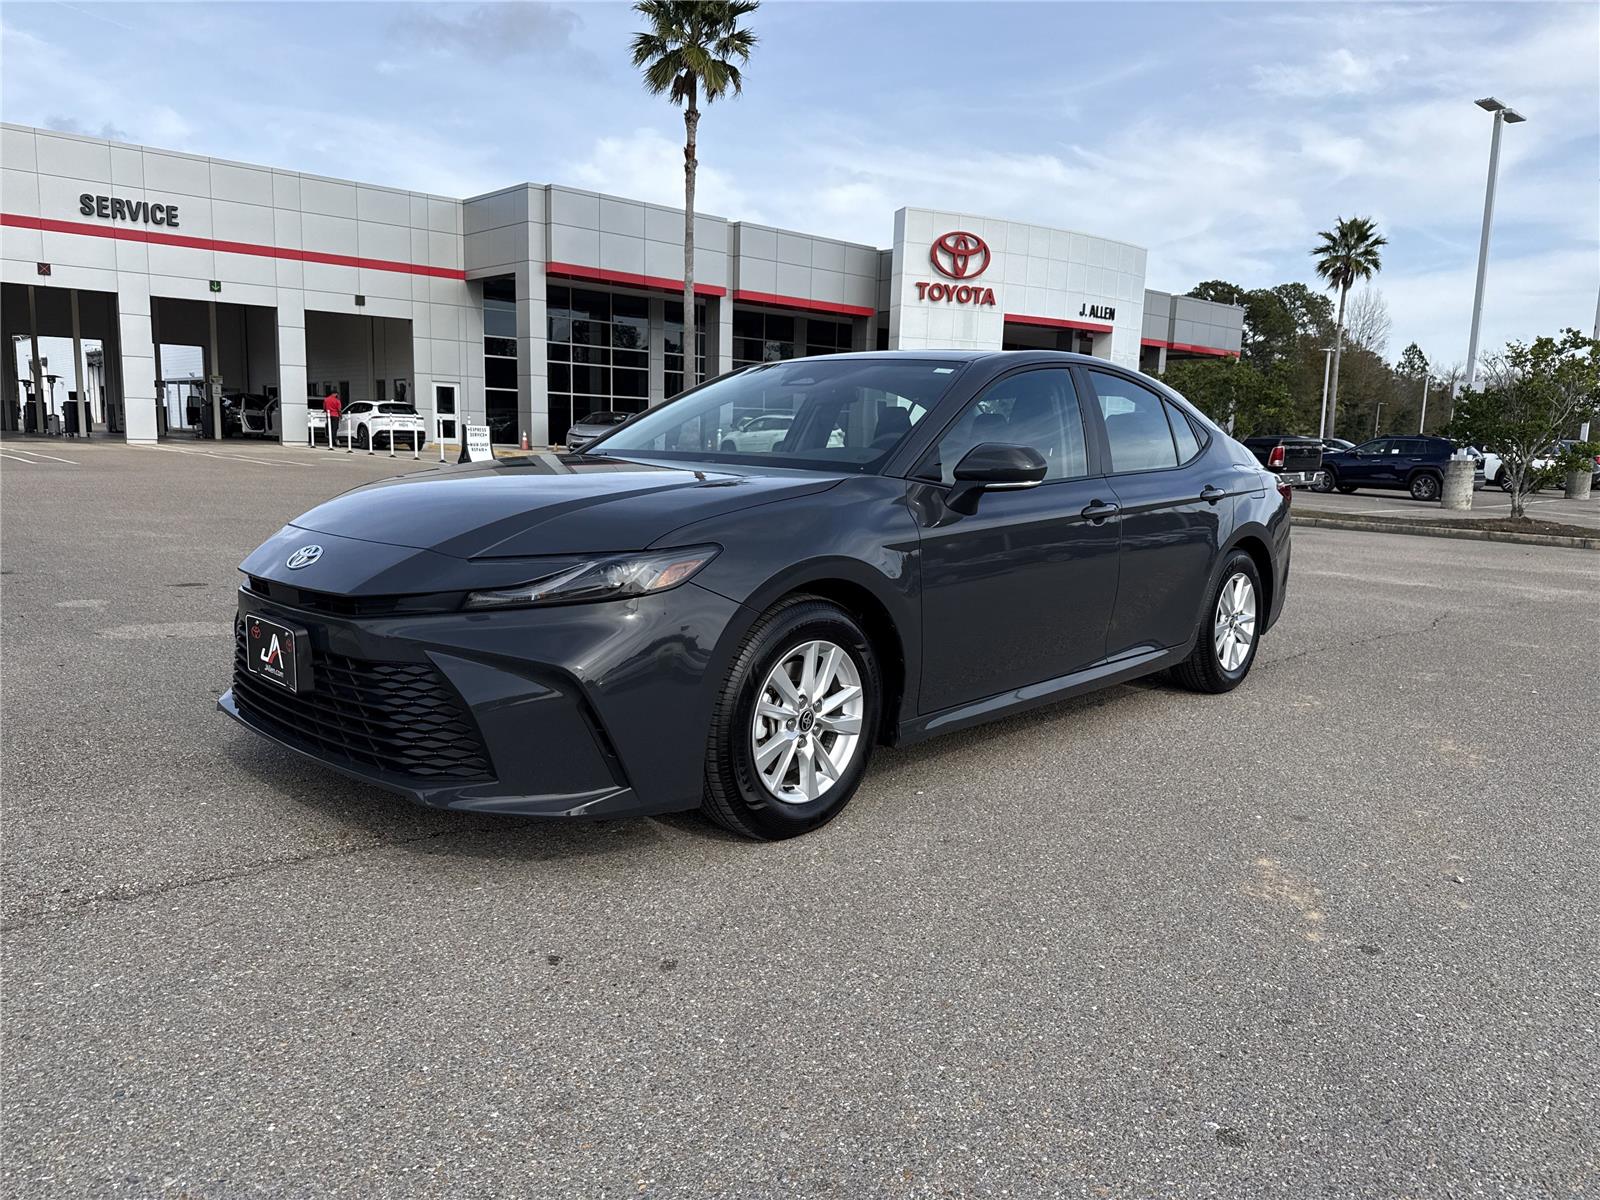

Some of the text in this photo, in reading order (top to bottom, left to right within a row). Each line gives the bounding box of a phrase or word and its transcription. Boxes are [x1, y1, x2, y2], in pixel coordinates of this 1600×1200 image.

[79, 193, 180, 227] SERVICE
[915, 282, 996, 306] TOYOTA
[1079, 303, 1116, 321] J. ALLEN
